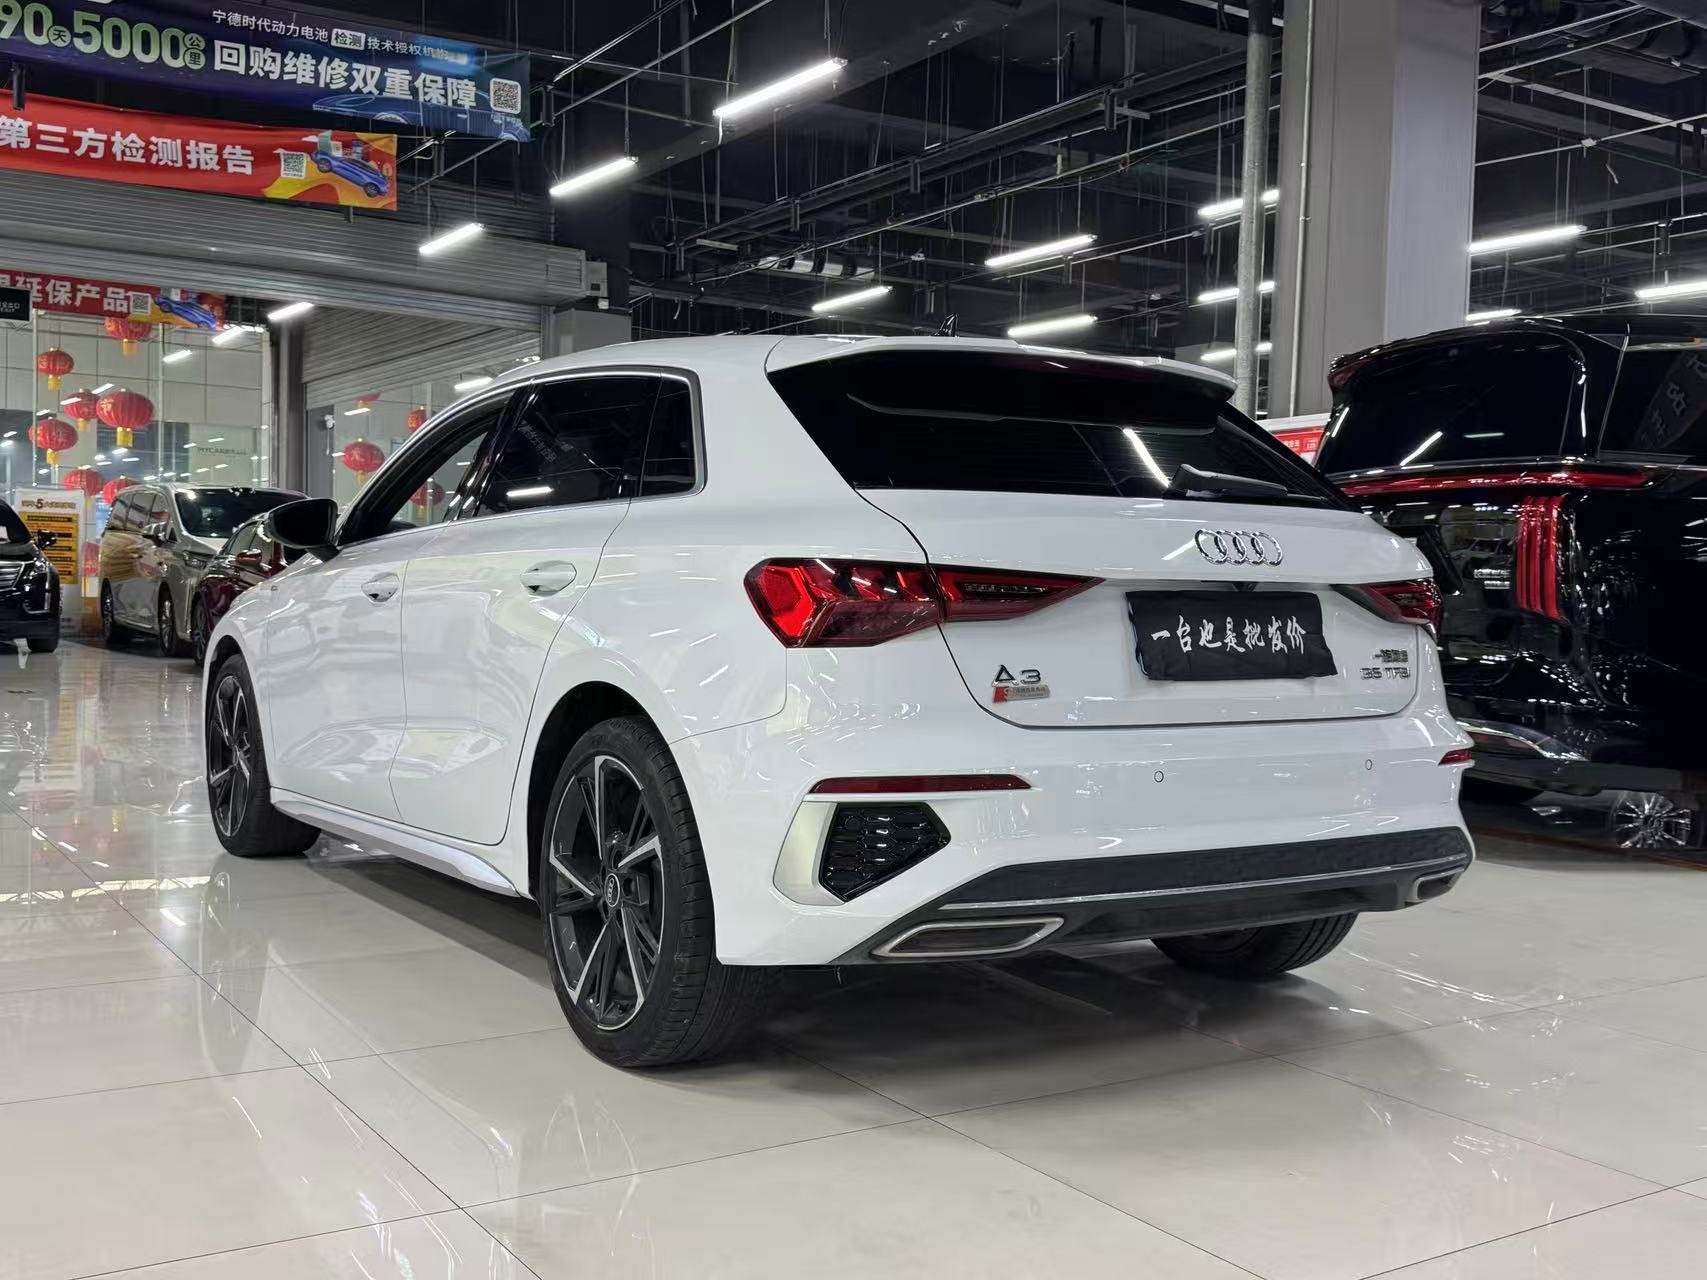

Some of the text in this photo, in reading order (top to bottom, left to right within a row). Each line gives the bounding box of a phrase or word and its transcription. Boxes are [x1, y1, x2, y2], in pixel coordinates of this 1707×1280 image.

[213, 39, 477, 109] 回购维修双重保障
[0, 115, 254, 175] 第三方检测报告
[1151, 615, 1306, 654] 一台也是批发价
[994, 664, 1041, 685] A3
